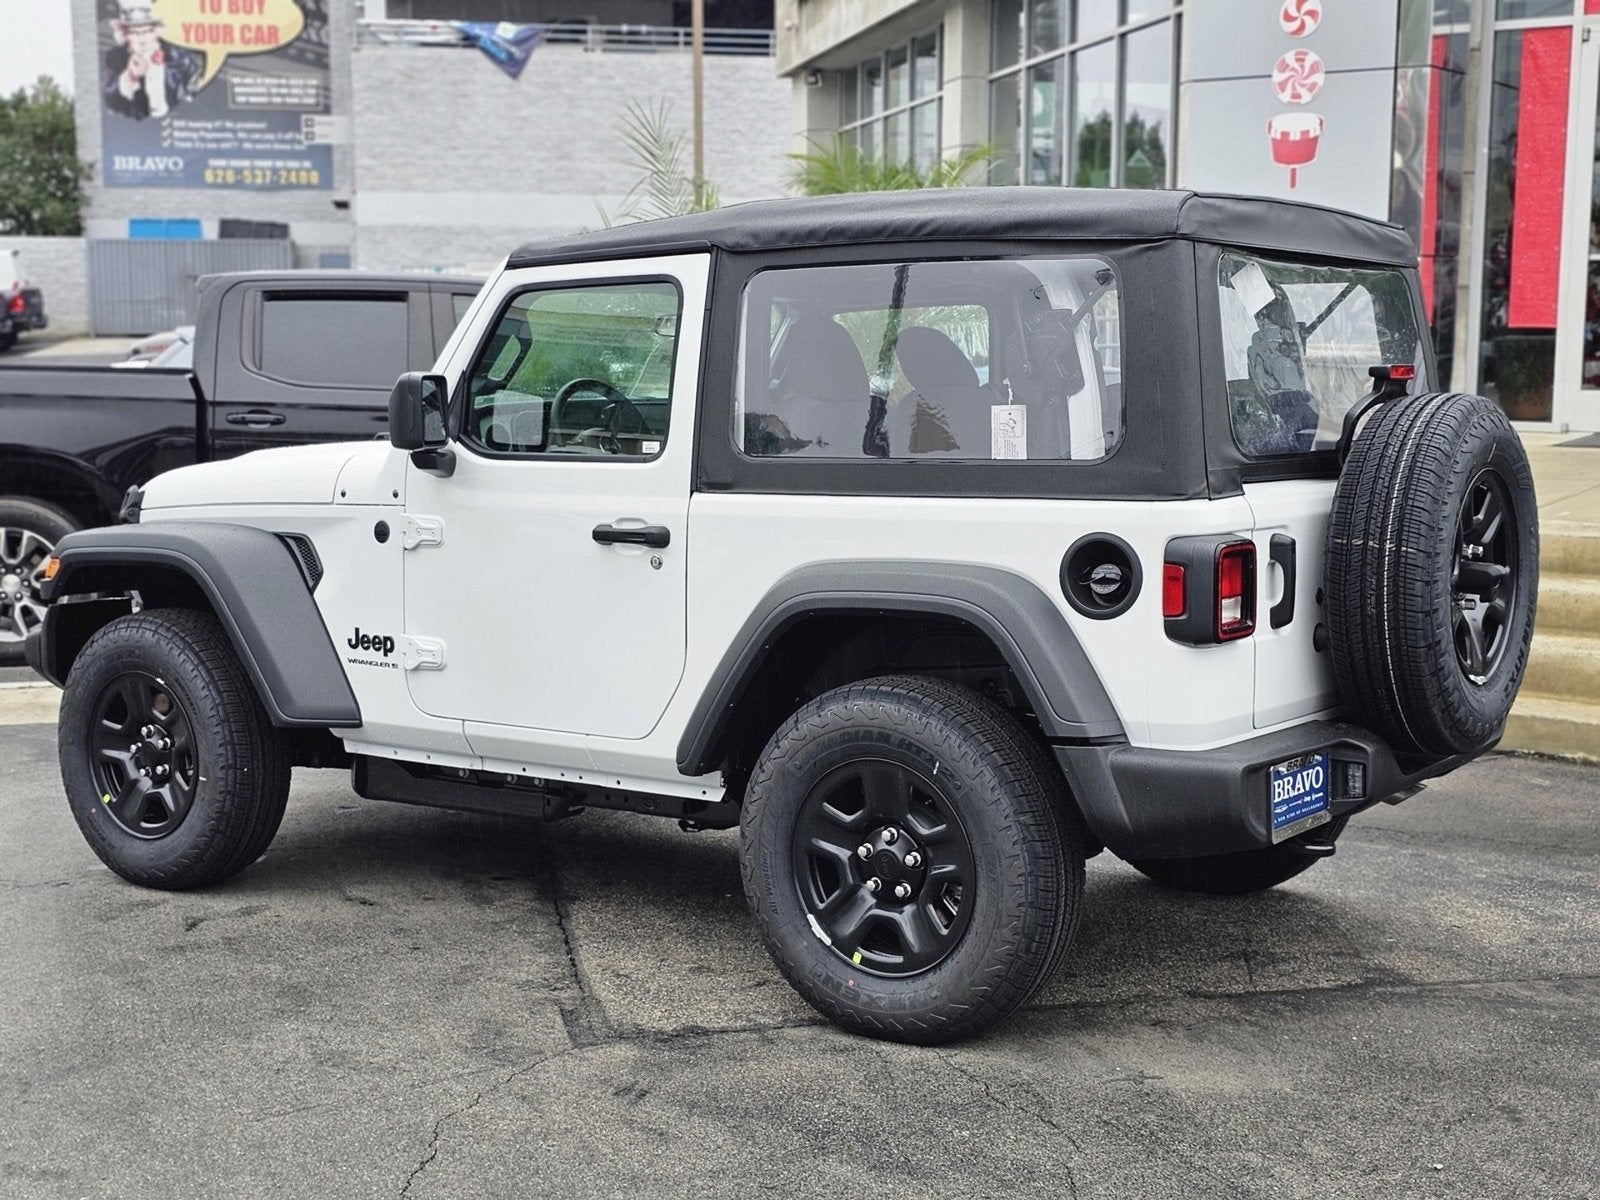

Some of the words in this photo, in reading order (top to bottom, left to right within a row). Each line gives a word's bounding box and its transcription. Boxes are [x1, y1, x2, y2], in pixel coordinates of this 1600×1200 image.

[199, 0, 222, 15] TO
[228, 0, 266, 15] BUY
[181, 22, 234, 45] YOUR
[240, 24, 280, 46] CAR
[113, 155, 184, 171] BRAVO
[347, 627, 395, 657] Jeep
[347, 657, 391, 668] WRANGLER
[1273, 766, 1324, 803] BRAVO
